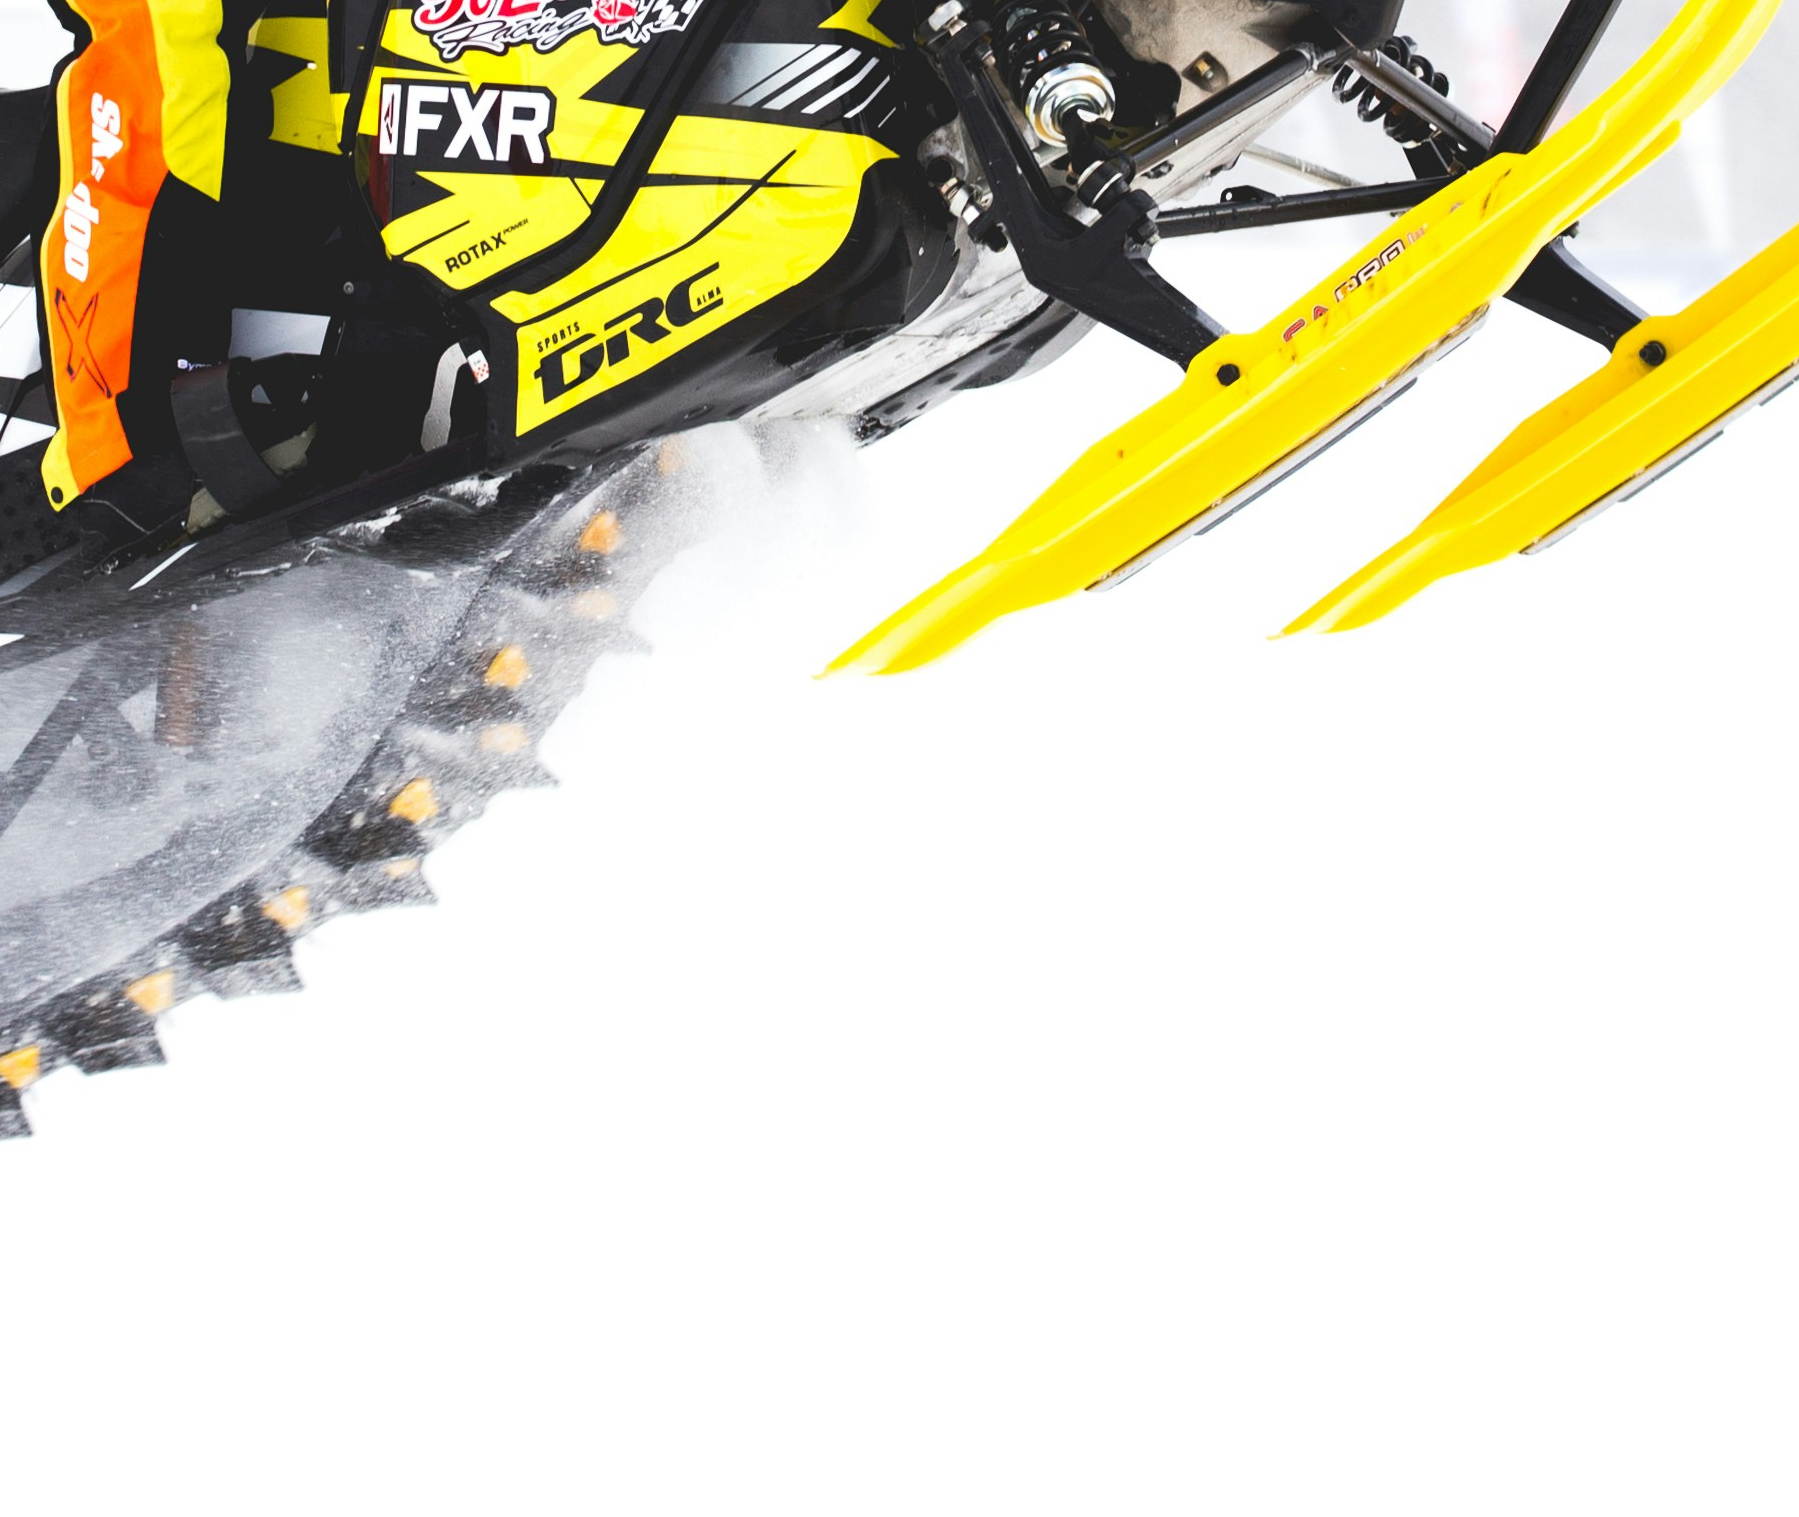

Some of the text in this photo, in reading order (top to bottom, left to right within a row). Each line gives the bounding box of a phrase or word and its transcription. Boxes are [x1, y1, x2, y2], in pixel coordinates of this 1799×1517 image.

[438, 9, 590, 54] Racing
[403, 85, 550, 163] FXR
[445, 218, 529, 273] ROTAX POWER
[696, 285, 723, 307] ALMA
[537, 321, 581, 353] SPORTS
